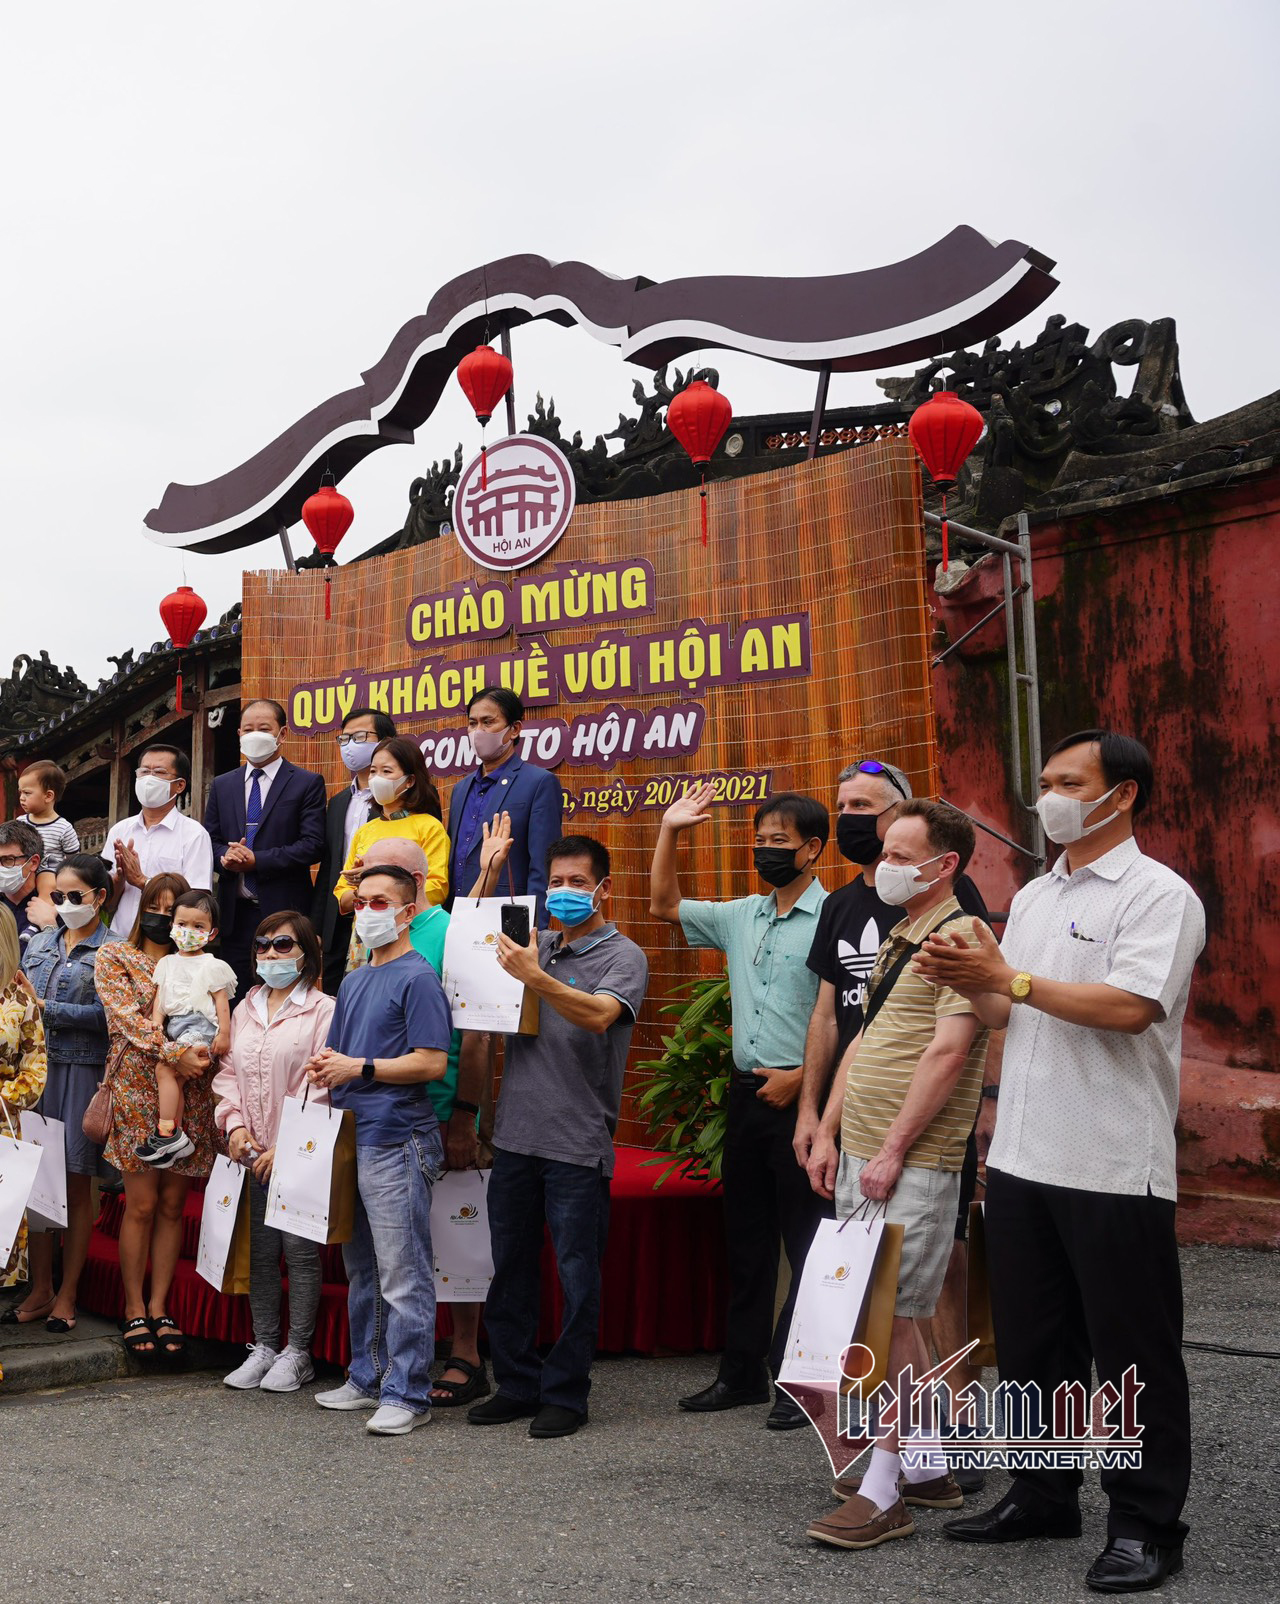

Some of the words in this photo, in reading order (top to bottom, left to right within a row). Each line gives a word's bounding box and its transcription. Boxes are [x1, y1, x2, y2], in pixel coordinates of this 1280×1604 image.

[493, 538, 512, 555] HỘI
[515, 537, 531, 550] AN
[411, 587, 505, 642] CHÀO
[521, 566, 647, 625] MỪNG
[293, 677, 357, 729] QUÝ
[369, 664, 486, 716] KHÁCH
[500, 642, 550, 698] VỀ
[564, 640, 631, 694] VỚI
[649, 627, 722, 689] HỘI
[740, 622, 802, 673] AN
[520, 726, 562, 762] TO
[572, 712, 636, 763] HỘI
[643, 712, 697, 750] AN
[582, 785, 639, 813] ngày
